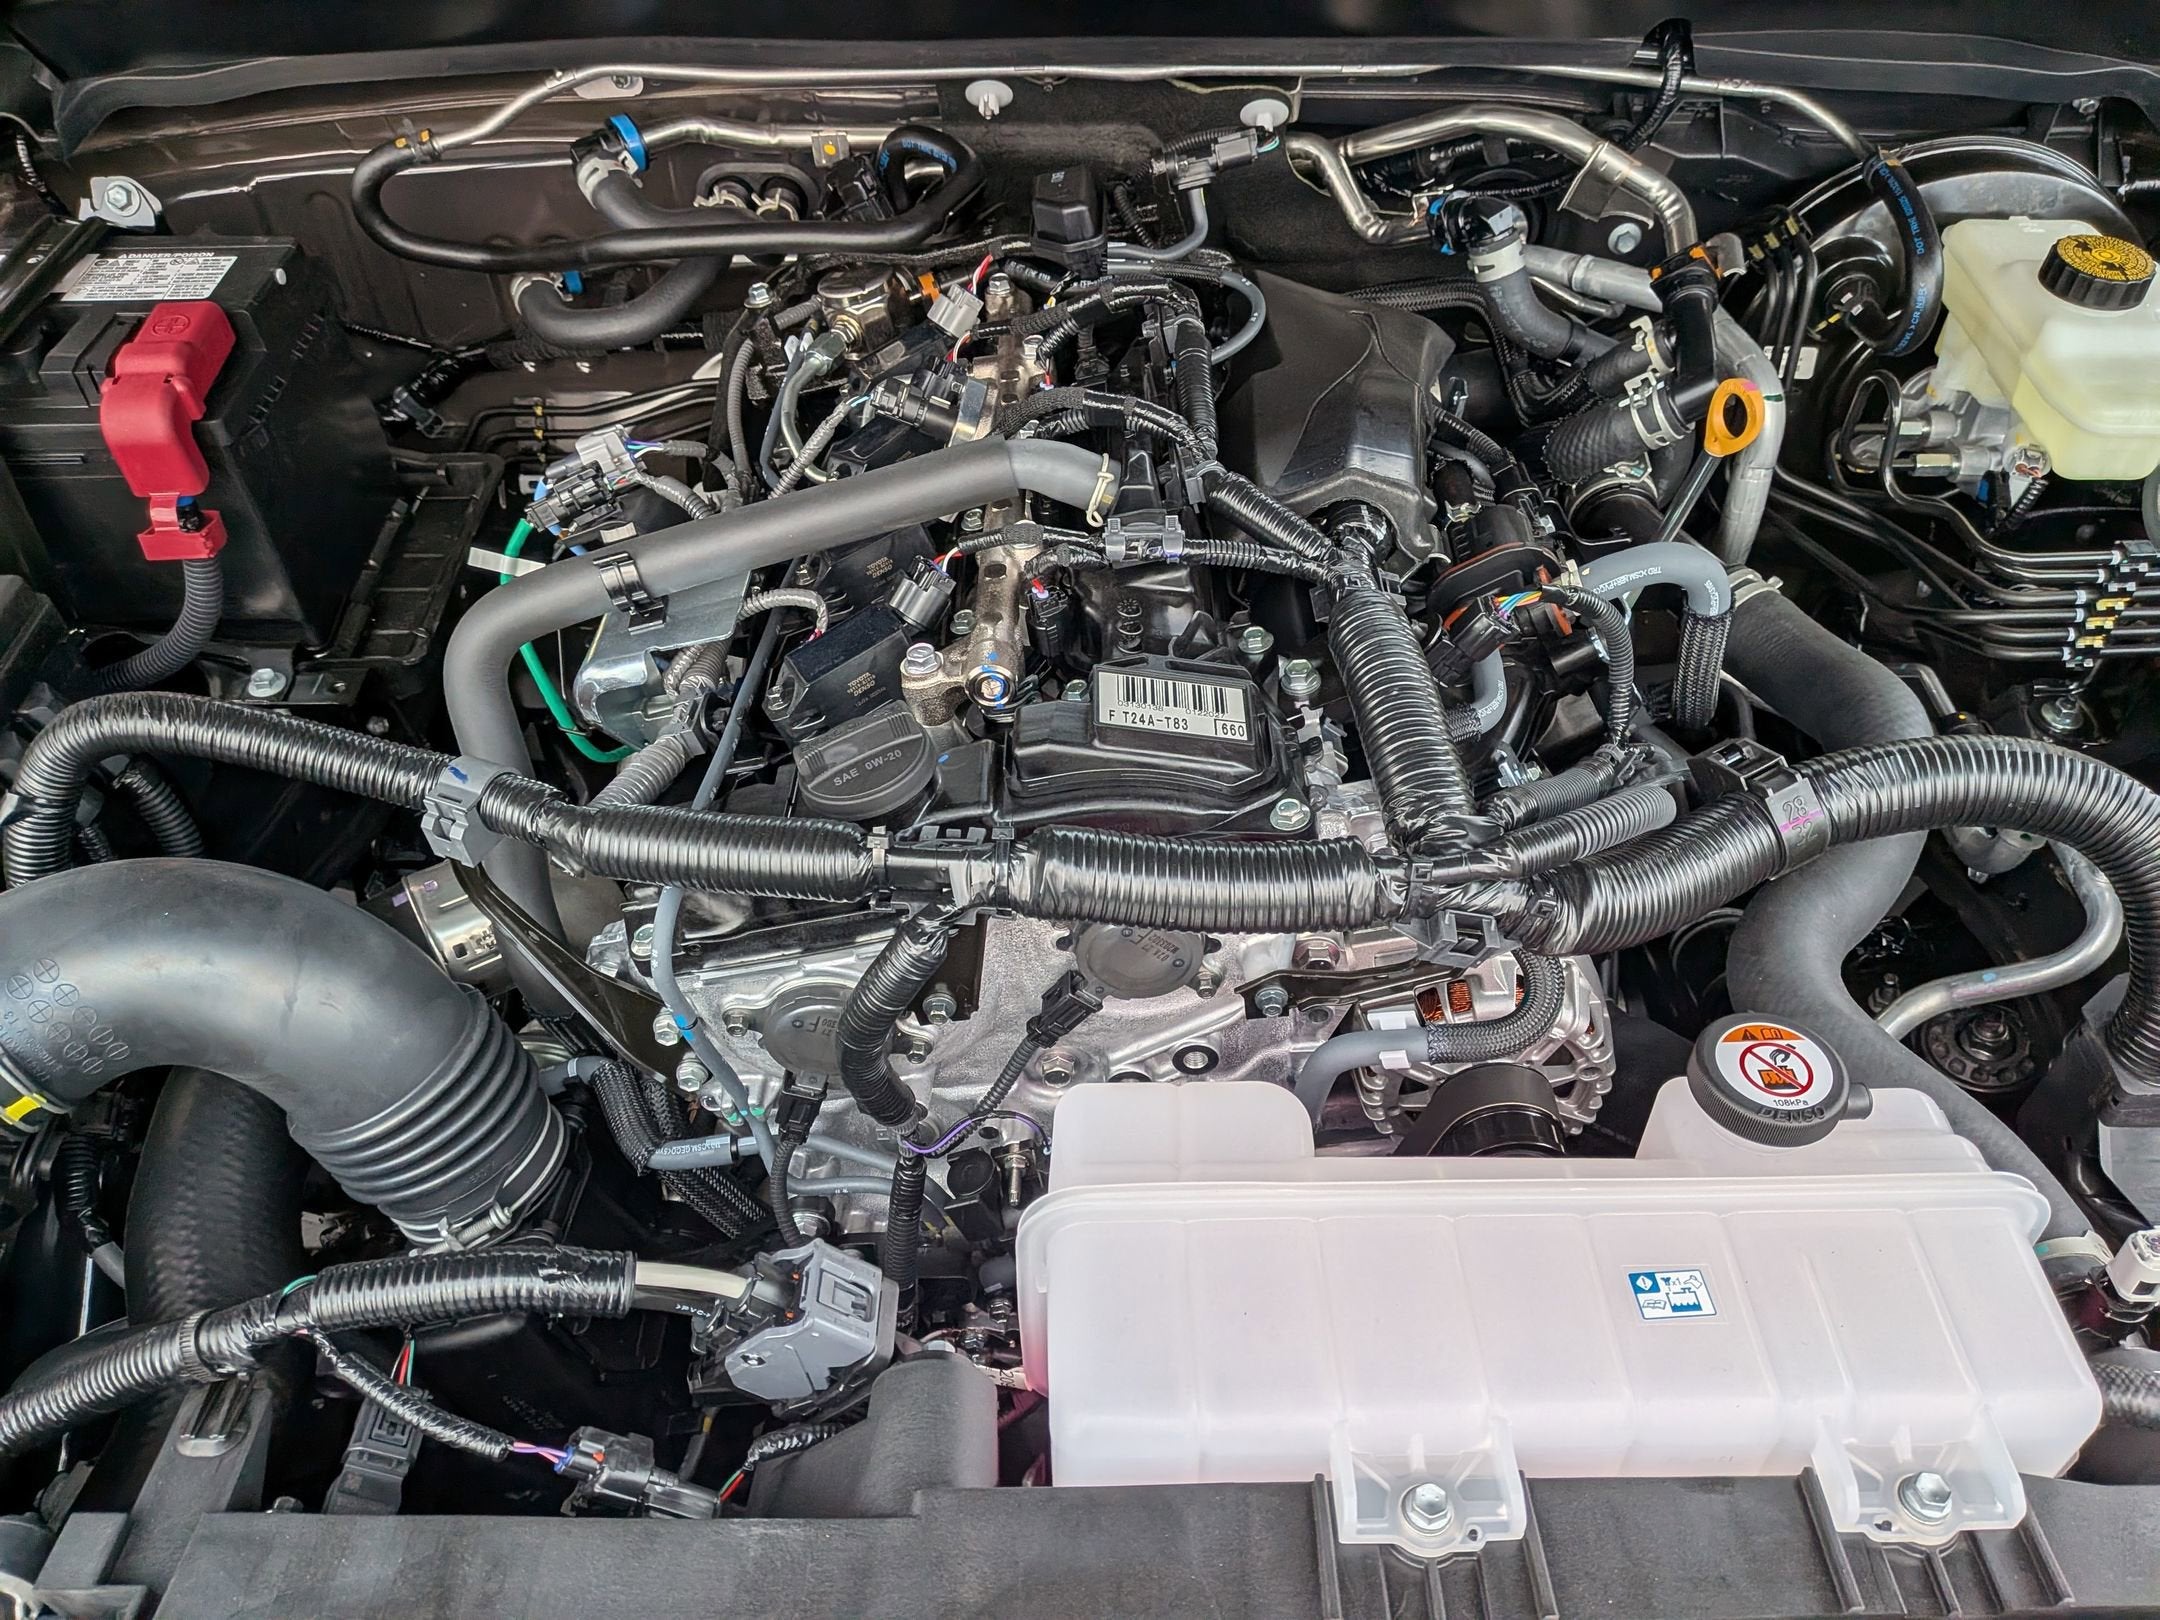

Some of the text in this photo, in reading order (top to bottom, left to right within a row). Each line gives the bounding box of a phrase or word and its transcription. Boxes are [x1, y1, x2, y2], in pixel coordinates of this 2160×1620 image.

[847, 672, 872, 688] TOYOTA
[853, 680, 876, 697] DENSO
[1108, 710, 1245, 738] F T24A-T83 660
[833, 749, 903, 786] SAE 0W-20
[1782, 795, 1807, 825] 28
[1791, 818, 1818, 847] 32
[1758, 1105, 1826, 1124] DENSO
[1773, 1099, 1809, 1107] 108kPa
